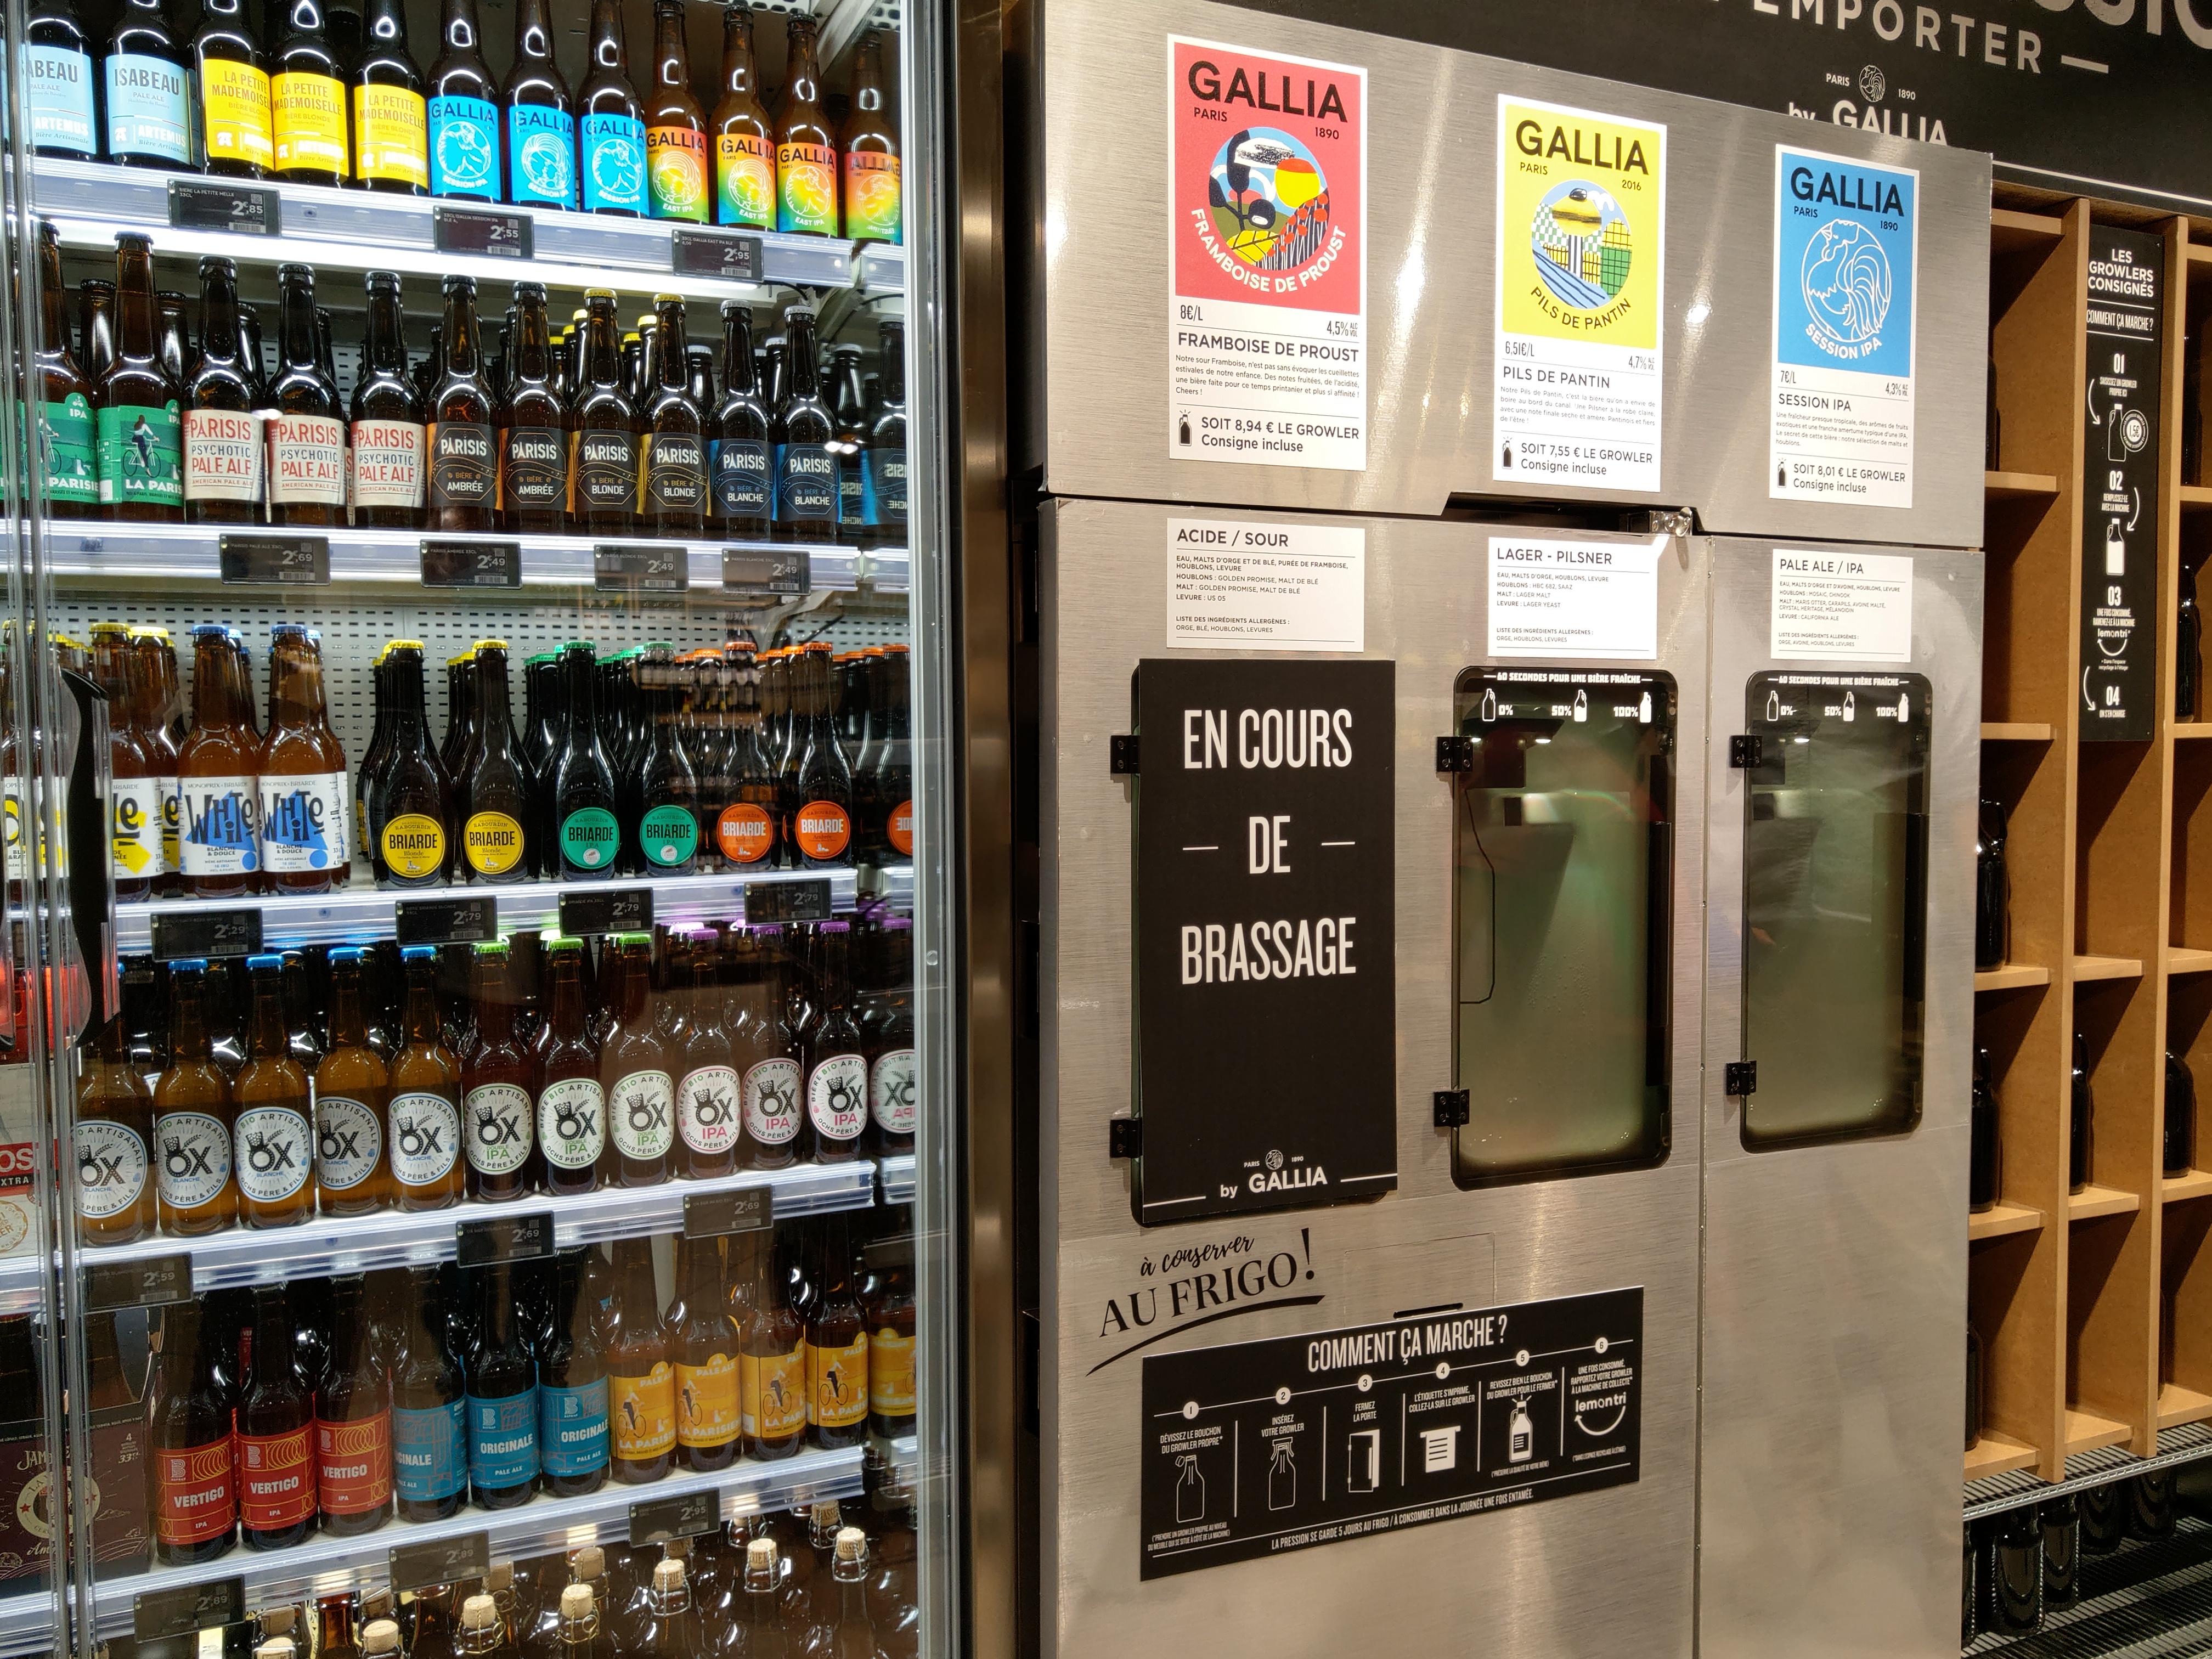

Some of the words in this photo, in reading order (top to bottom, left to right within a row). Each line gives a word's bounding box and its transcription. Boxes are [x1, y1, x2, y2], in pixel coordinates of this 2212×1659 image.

[115, 68, 179, 95] ISABEAU
[281, 83, 291, 95] LA
[294, 83, 328, 98] PETITE
[1188, 60, 1348, 123] GALLIA
[1826, 73, 1850, 87] PARIS
[1898, 88, 1916, 100] 1890
[275, 97, 341, 116] MADEMOISELLE
[431, 102, 495, 125] GALLIA
[35, 116, 88, 137] ARTEMUS
[585, 120, 645, 143] GALLIA
[1194, 107, 1227, 122] PARIS
[1315, 127, 1339, 139] 1890
[647, 132, 705, 153] GALLIA
[1516, 120, 1649, 175] GALLIA
[780, 148, 835, 169] GALLIA
[1520, 162, 1548, 175] PARIS
[1622, 180, 1641, 191] 2016
[1791, 167, 1904, 217] GALLIA
[663, 203, 681, 213] EAST
[1794, 206, 1818, 218] PARIS
[1880, 221, 1898, 231] 1890
[1192, 208, 1270, 292] FRAMBOISE
[1275, 276, 1297, 293] DE
[1301, 225, 1347, 287] PROUST
[2112, 249, 2132, 263] LES
[2089, 261, 2153, 283] GROWLERS
[2088, 276, 2154, 297] CONSIGNÉS
[1180, 305, 1203, 321] 8€/L
[1531, 286, 1558, 319] PILS
[1562, 312, 1579, 329] DE
[1585, 298, 1632, 330] PANTIN
[2086, 309, 2116, 326] COMMENT
[2117, 313, 2124, 330] ÇA
[2125, 315, 2149, 330] MARCHE
[1178, 332, 1269, 354] FRAMBOISE
[1275, 342, 1295, 356] DE
[1300, 345, 1358, 362] PROUST
[1805, 323, 1858, 359] SESSION
[1862, 337, 1882, 356] IPA
[1212, 358, 1247, 368] Framboise,
[1292, 365, 1317, 375] évoquer
[1328, 368, 1359, 378] cueillettes
[2113, 353, 2125, 374] 01
[1504, 366, 1532, 380] PILS
[1538, 370, 1555, 383] DE
[1561, 373, 1610, 388] PANTIN
[1779, 393, 1829, 409] SESSION
[1833, 399, 1852, 411] IPA
[70, 409, 87, 419] IPA
[190, 415, 252, 441] PARISIS
[358, 426, 414, 449] PARISIS
[1201, 416, 1231, 430] SOIT
[1235, 419, 1261, 433] 8,94
[1266, 422, 1274, 433] €
[1278, 422, 1293, 435] LE
[1296, 424, 1359, 439] GROWLER
[192, 444, 251, 459] PSYCHOTIC
[441, 437, 487, 456] PARISIS
[512, 442, 557, 460] PARISIS
[584, 444, 628, 461] PARISIS
[1201, 435, 1258, 450] Consigne
[1262, 438, 1304, 452] incluse
[1521, 443, 1546, 455] SOIT
[1550, 445, 1570, 458] 7,55
[1573, 447, 1580, 457] €
[1584, 448, 1596, 459] LE
[1600, 450, 1652, 463] GROWLER
[192, 457, 223, 474] PALE
[790, 456, 831, 473] PARISIS
[1521, 459, 1568, 473] Consigne
[1572, 462, 1607, 475] incluse
[1794, 464, 1815, 475] SOIT
[1818, 466, 1835, 477] 8,01
[1838, 467, 1844, 477] €
[1847, 468, 1858, 478] LE
[1860, 470, 1905, 482] GROWLER
[447, 481, 483, 492] AMBRÉE
[518, 484, 554, 495] AMBRÉE
[591, 485, 624, 494] BLONDE
[1794, 478, 1834, 492] Consigne
[1837, 481, 1866, 493] incluse
[2109, 471, 2123, 491] 02
[795, 495, 830, 506] BLANCHE
[1177, 528, 1227, 544] ACIDE
[1232, 530, 1240, 546] /
[1245, 532, 1289, 547] SOUR
[1497, 548, 1543, 561] LAGER
[1557, 551, 1612, 565] PILSNER
[1780, 558, 1808, 571] PALE
[1812, 560, 1834, 572] ALE
[1837, 561, 1843, 574] /
[1847, 562, 1864, 574] IPA
[2108, 586, 2121, 606] 03
[2106, 686, 2120, 706] 04
[1184, 710, 1227, 769] EN
[1239, 708, 1352, 769] COURS
[568, 826, 613, 842] BRIARDE
[723, 821, 766, 837] BRIARDE
[801, 818, 844, 834] BRIARDE
[389, 833, 438, 849] BRIARDE
[1249, 816, 1290, 874] DE
[1182, 917, 1356, 985] BRASSAGE
[834, 1113, 857, 1126] IPA
[259, 1114, 309, 1153] ARTISANALE
[565, 1143, 588, 1154] IPA
[1220, 1184, 1238, 1199] by
[1249, 1166, 1328, 1194] GALLIA
[1140, 1257, 1156, 1277] à
[1163, 1235, 1255, 1273] conserver
[1098, 1287, 1156, 1338] AU
[1308, 1330, 1396, 1373] COMMENT
[1400, 1328, 1422, 1365] ÇA
[1426, 1316, 1494, 1355] MARCHE
[1498, 1314, 1508, 1344] ?
[1355, 1401, 1375, 1412] FERMEZ
[1576, 1392, 1626, 1412] lemontri
[1272, 1414, 1294, 1425] INSÉREZ
[1361, 1411, 1376, 1420] PORTE
[561, 1420, 609, 1442] ORIGINALE
[1160, 1431, 1186, 1443] DÉVISSEZ
[1187, 1430, 1194, 1439] LE
[1194, 1426, 1221, 1437] BOUCHON
[1262, 1426, 1278, 1437] VOTRE
[1279, 1423, 1304, 1434] GROWLER
[481, 1434, 533, 1454] ORIGINALE
[323, 1464, 368, 1479] VERTIGO
[174, 1486, 225, 1509] VERTIGO
[195, 1521, 208, 1530] IPA
